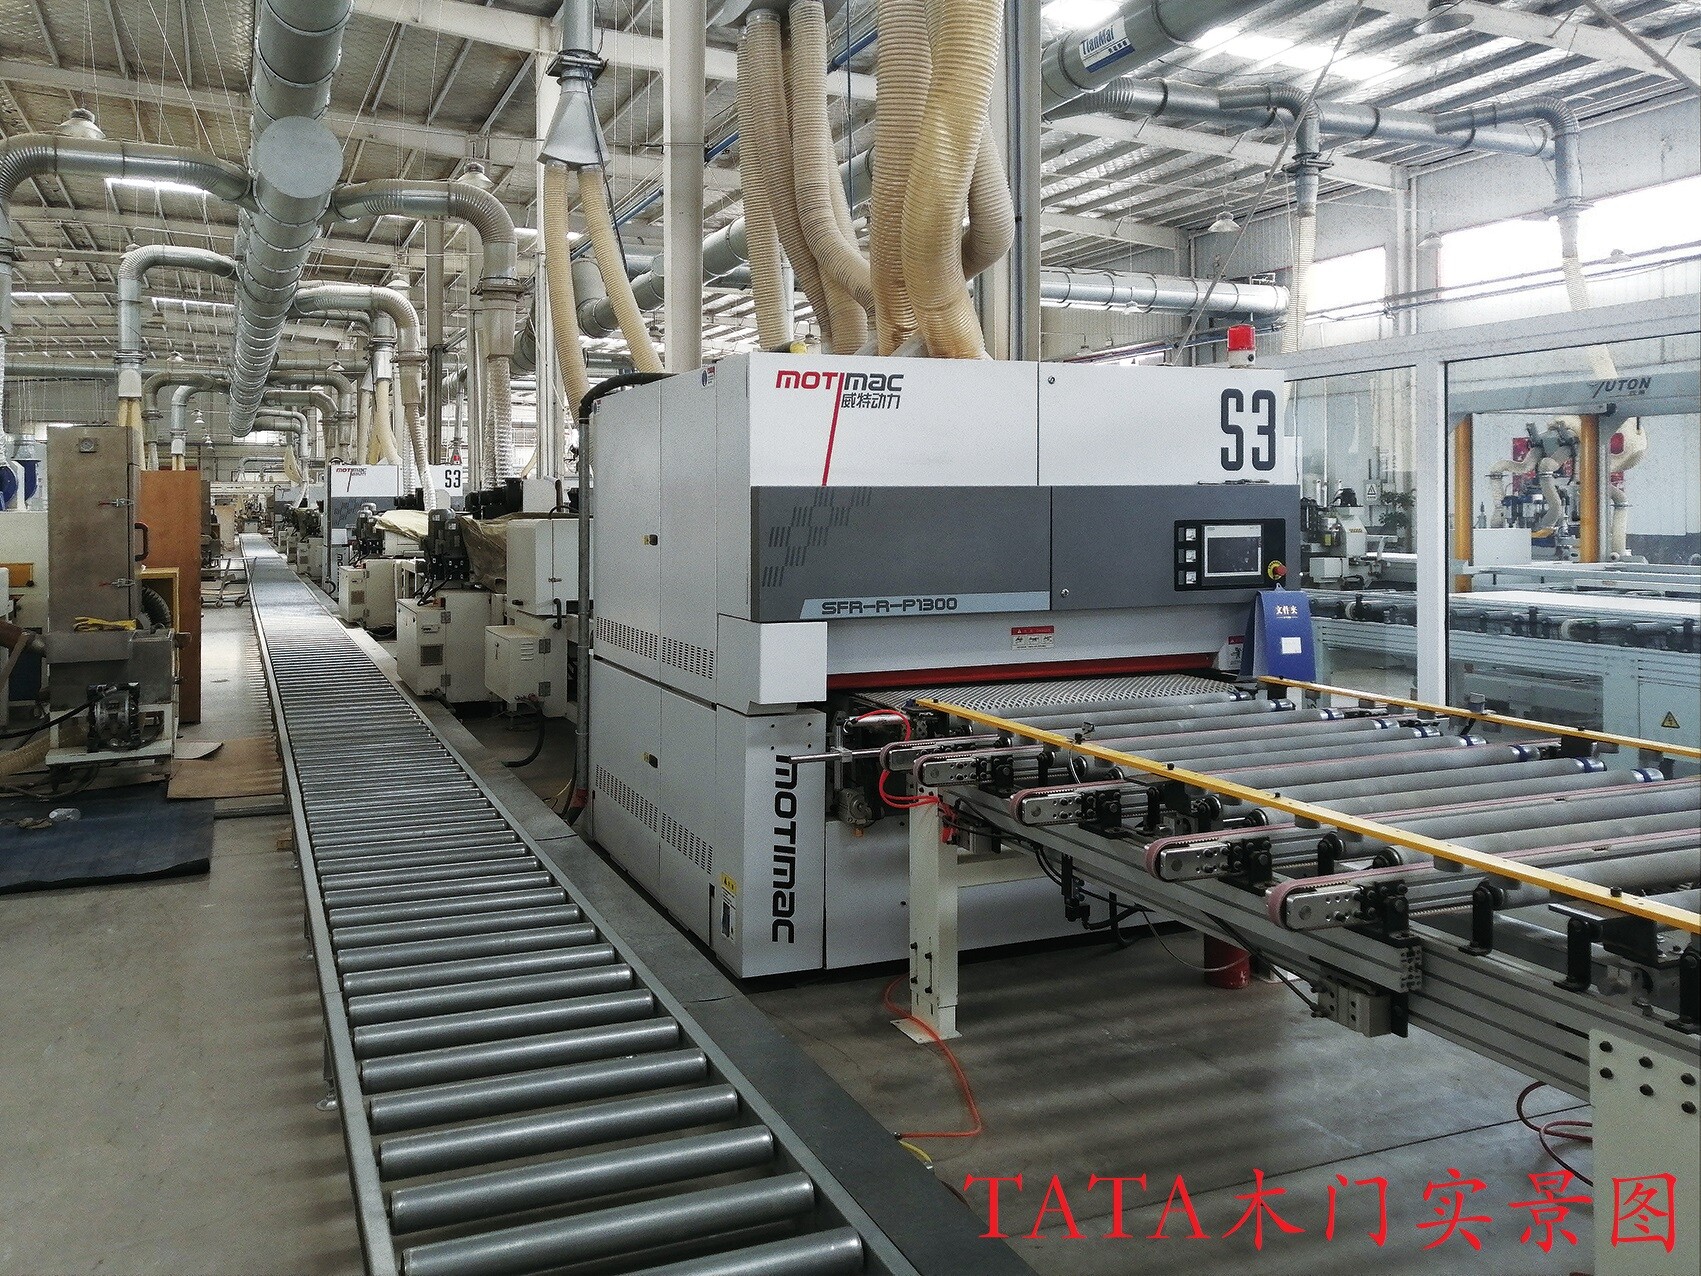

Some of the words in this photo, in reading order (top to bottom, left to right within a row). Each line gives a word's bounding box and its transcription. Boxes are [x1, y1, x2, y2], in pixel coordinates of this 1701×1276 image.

[841, 393, 900, 409] 威特动力
[1221, 388, 1276, 471] S3
[444, 469, 461, 488] S3
[821, 597, 958, 615] SFR-R-P1300
[1275, 605, 1299, 615] 文件夹
